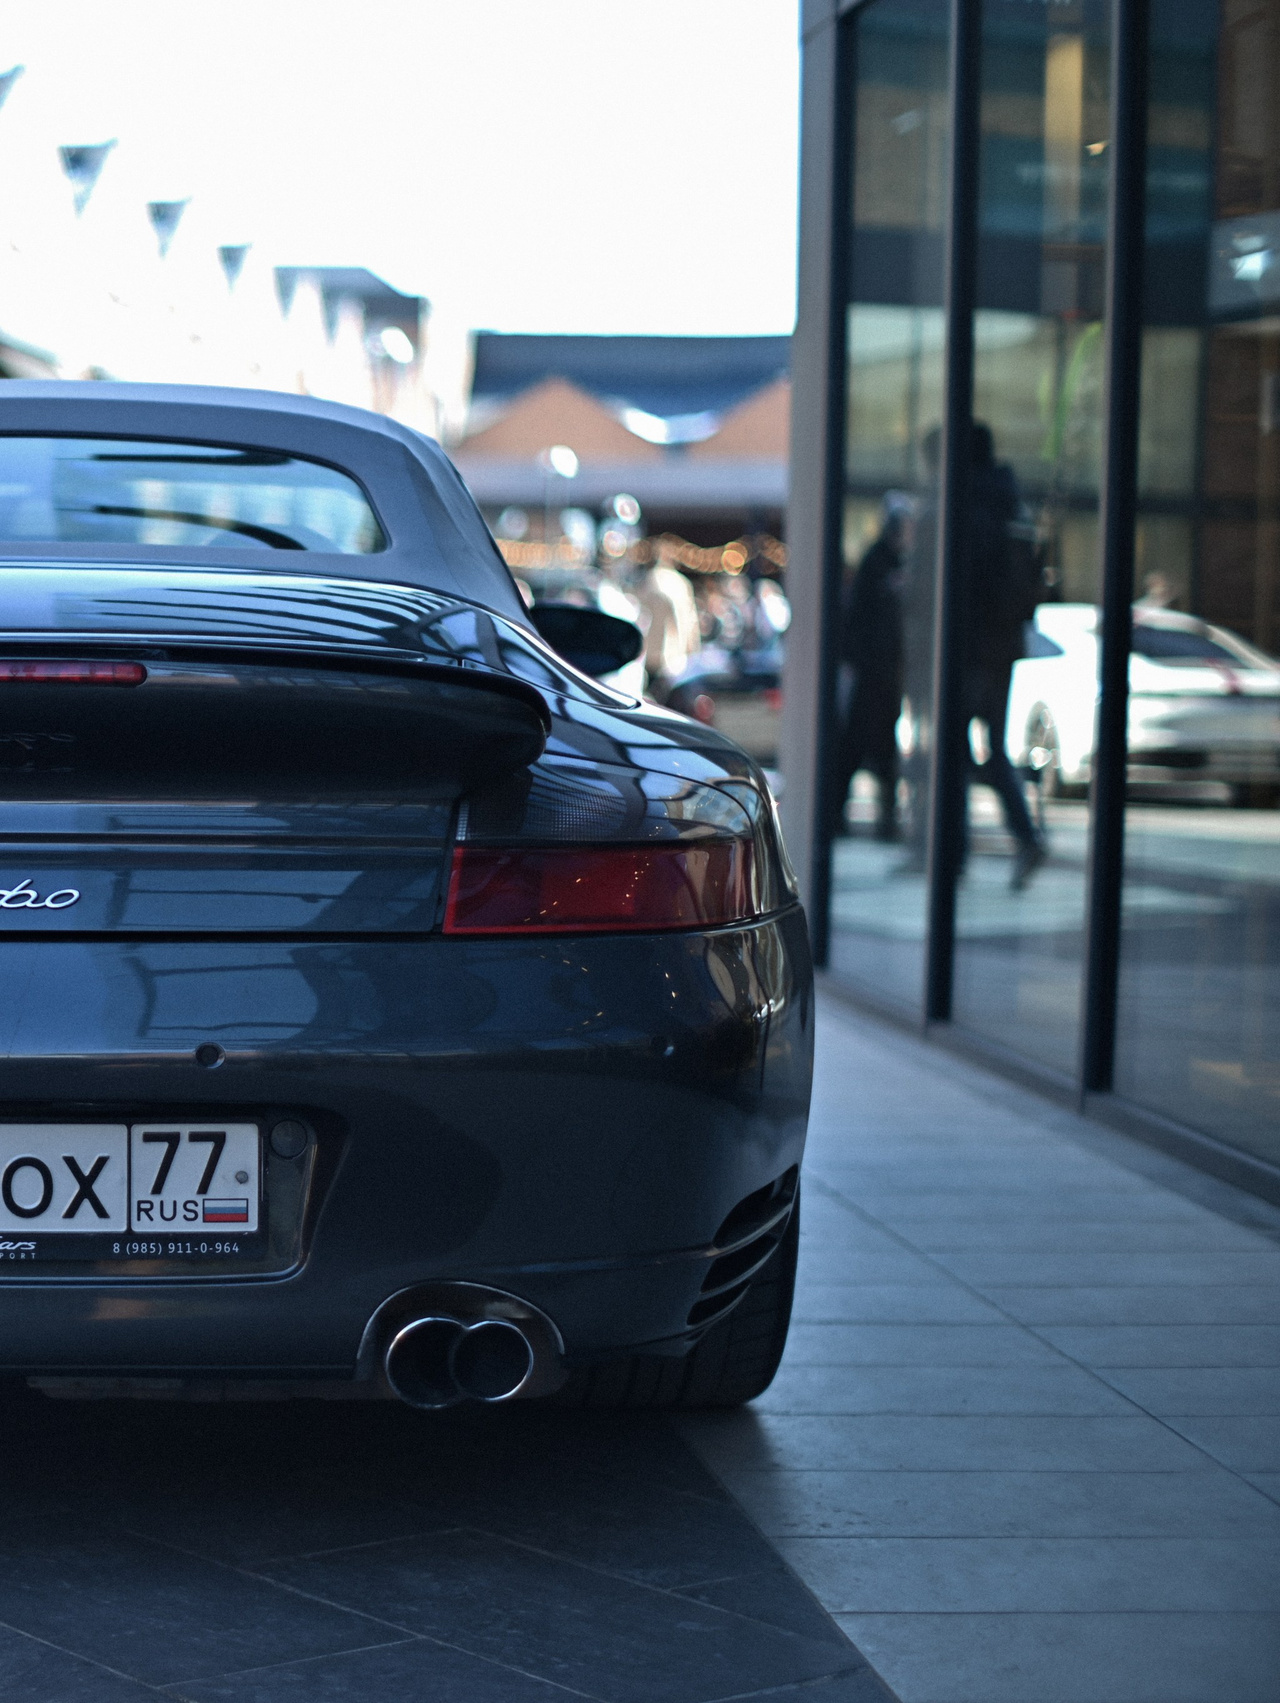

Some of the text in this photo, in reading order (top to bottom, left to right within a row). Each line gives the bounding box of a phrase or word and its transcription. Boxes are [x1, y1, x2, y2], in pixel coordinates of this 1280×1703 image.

[141, 1131, 228, 1196] 77
[136, 1199, 200, 1222] RUS
[112, 1242, 240, 1255] 8 (985) 911-0-964
